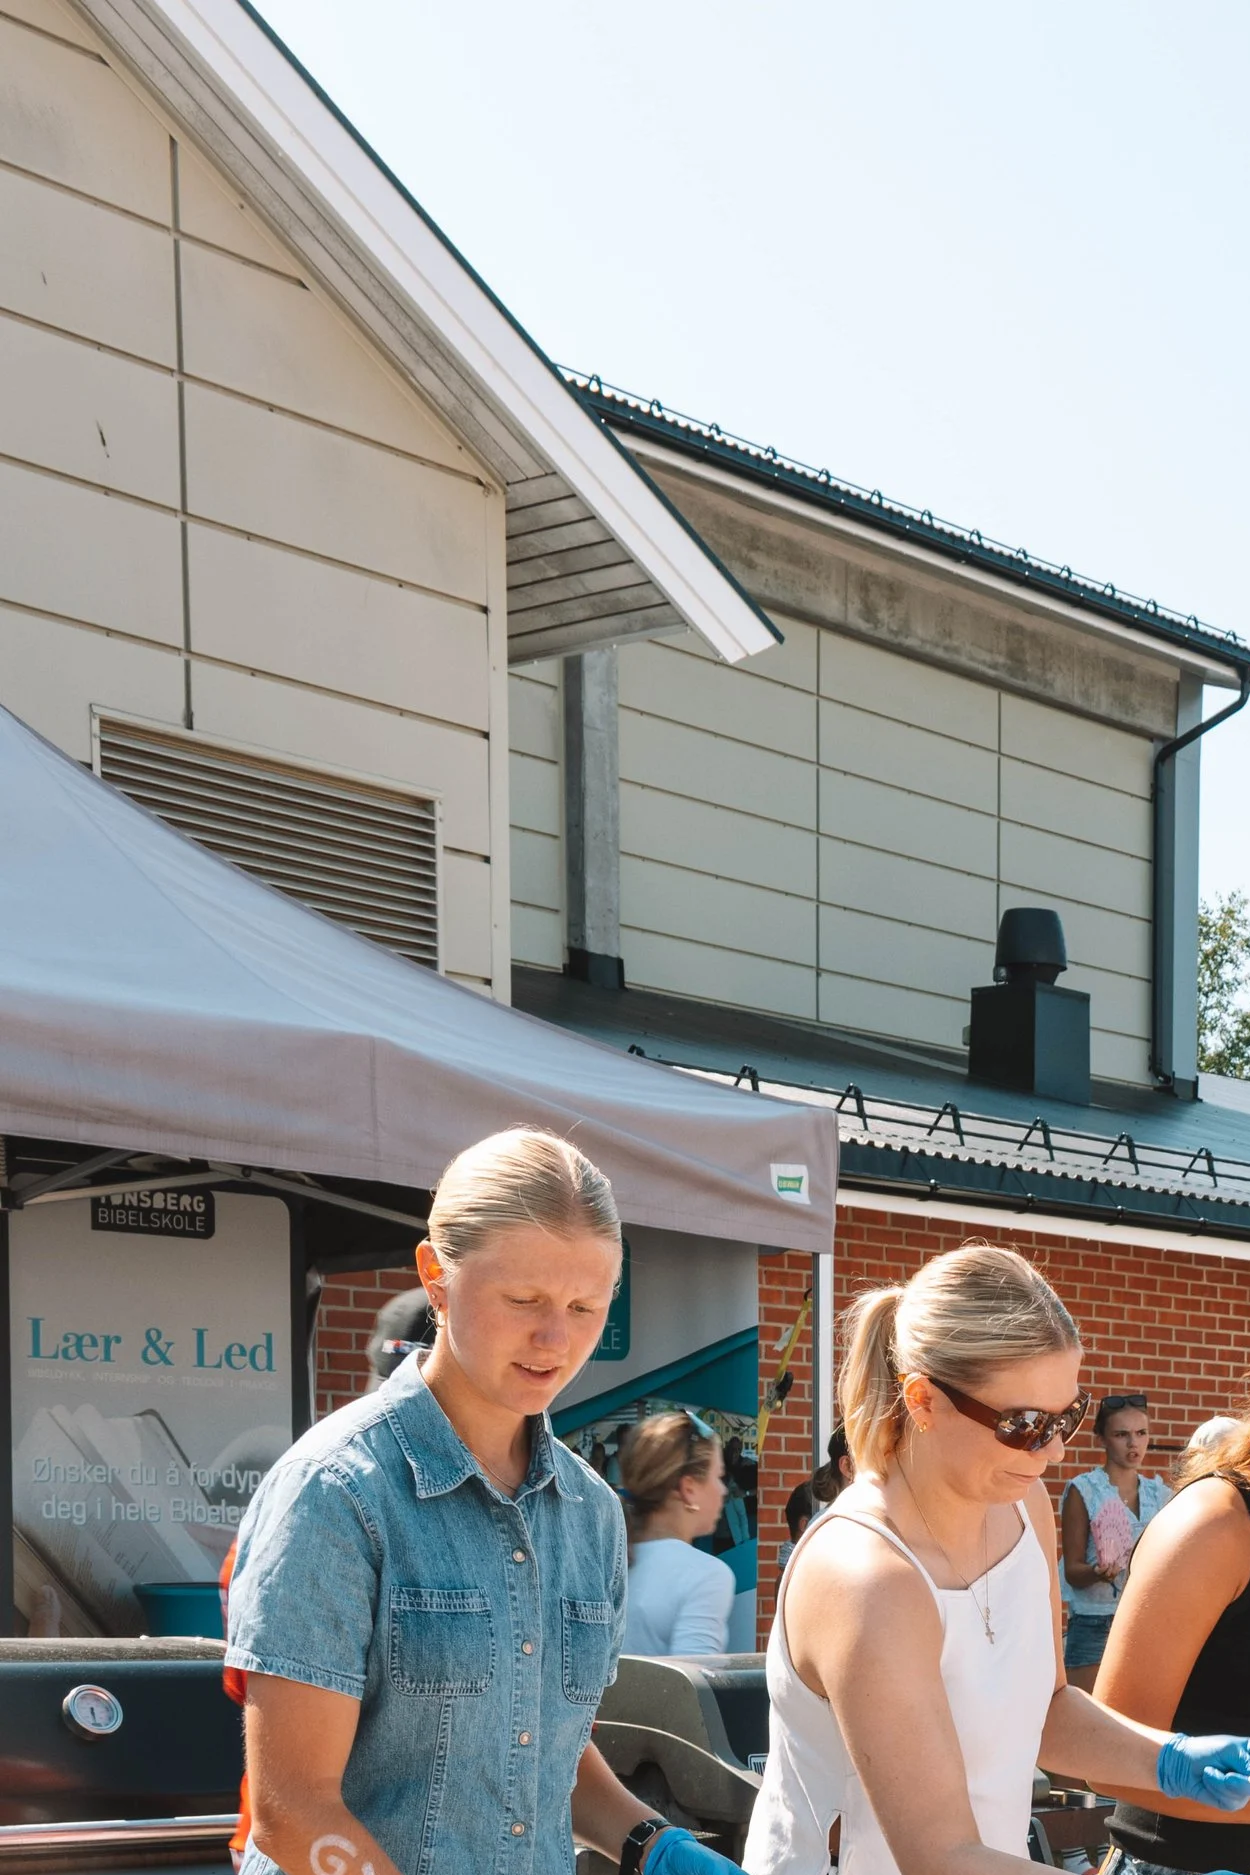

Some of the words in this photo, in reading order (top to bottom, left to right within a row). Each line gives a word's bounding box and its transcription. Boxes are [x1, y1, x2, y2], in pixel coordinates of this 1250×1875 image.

[100, 1190, 206, 1213] ØNSBERG
[98, 1207, 206, 1232] BIBELSKOLE
[26, 1316, 122, 1363] Lær
[141, 1327, 175, 1367] &
[192, 1327, 277, 1373] Led
[32, 1457, 119, 1484] Ønsker
[129, 1461, 157, 1486] du
[166, 1459, 180, 1486] å
[42, 1494, 87, 1525] deg
[96, 1497, 102, 1520] i
[111, 1498, 161, 1523] hele
